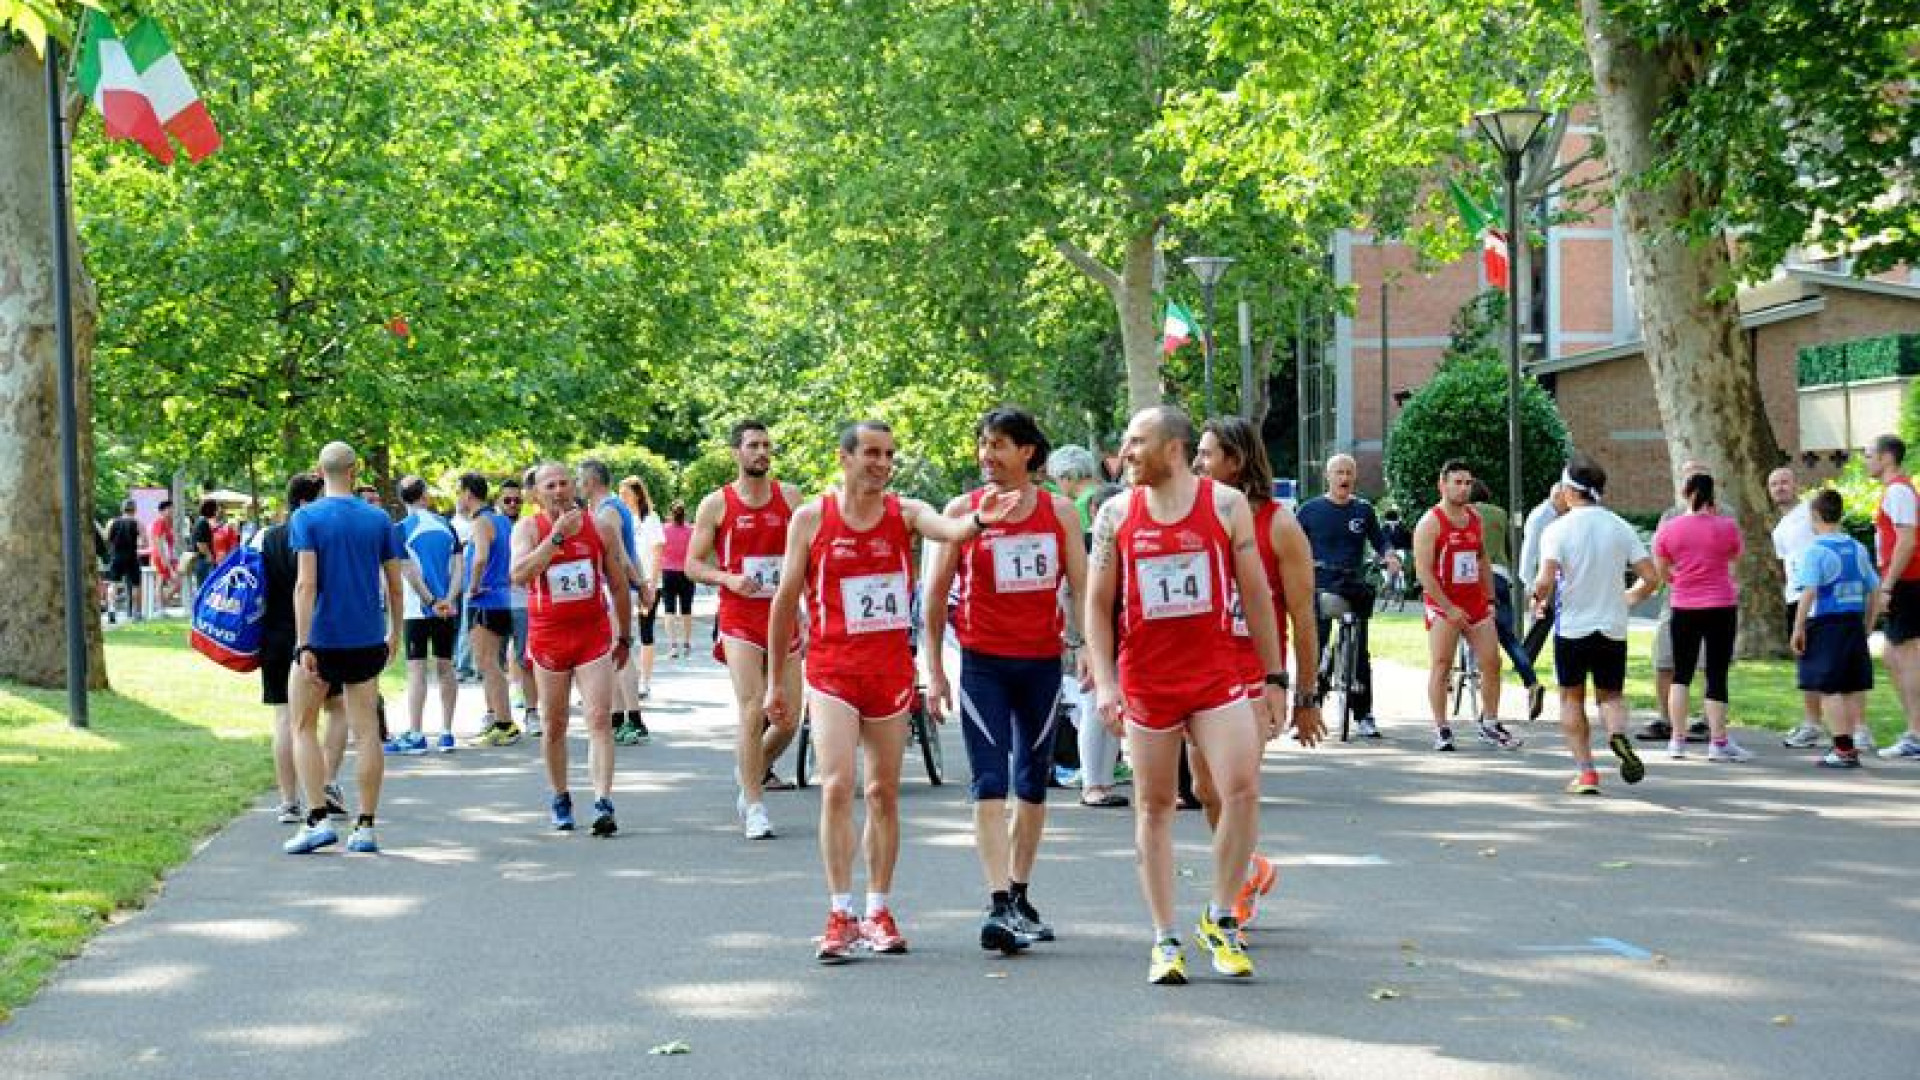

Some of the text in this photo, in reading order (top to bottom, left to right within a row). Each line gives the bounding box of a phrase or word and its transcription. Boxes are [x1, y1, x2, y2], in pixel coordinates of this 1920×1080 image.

[1012, 553, 1047, 579] 1-6
[560, 573, 589, 591] 2-6
[1158, 575, 1199, 603] 1-4
[861, 593, 897, 618] 2-4
